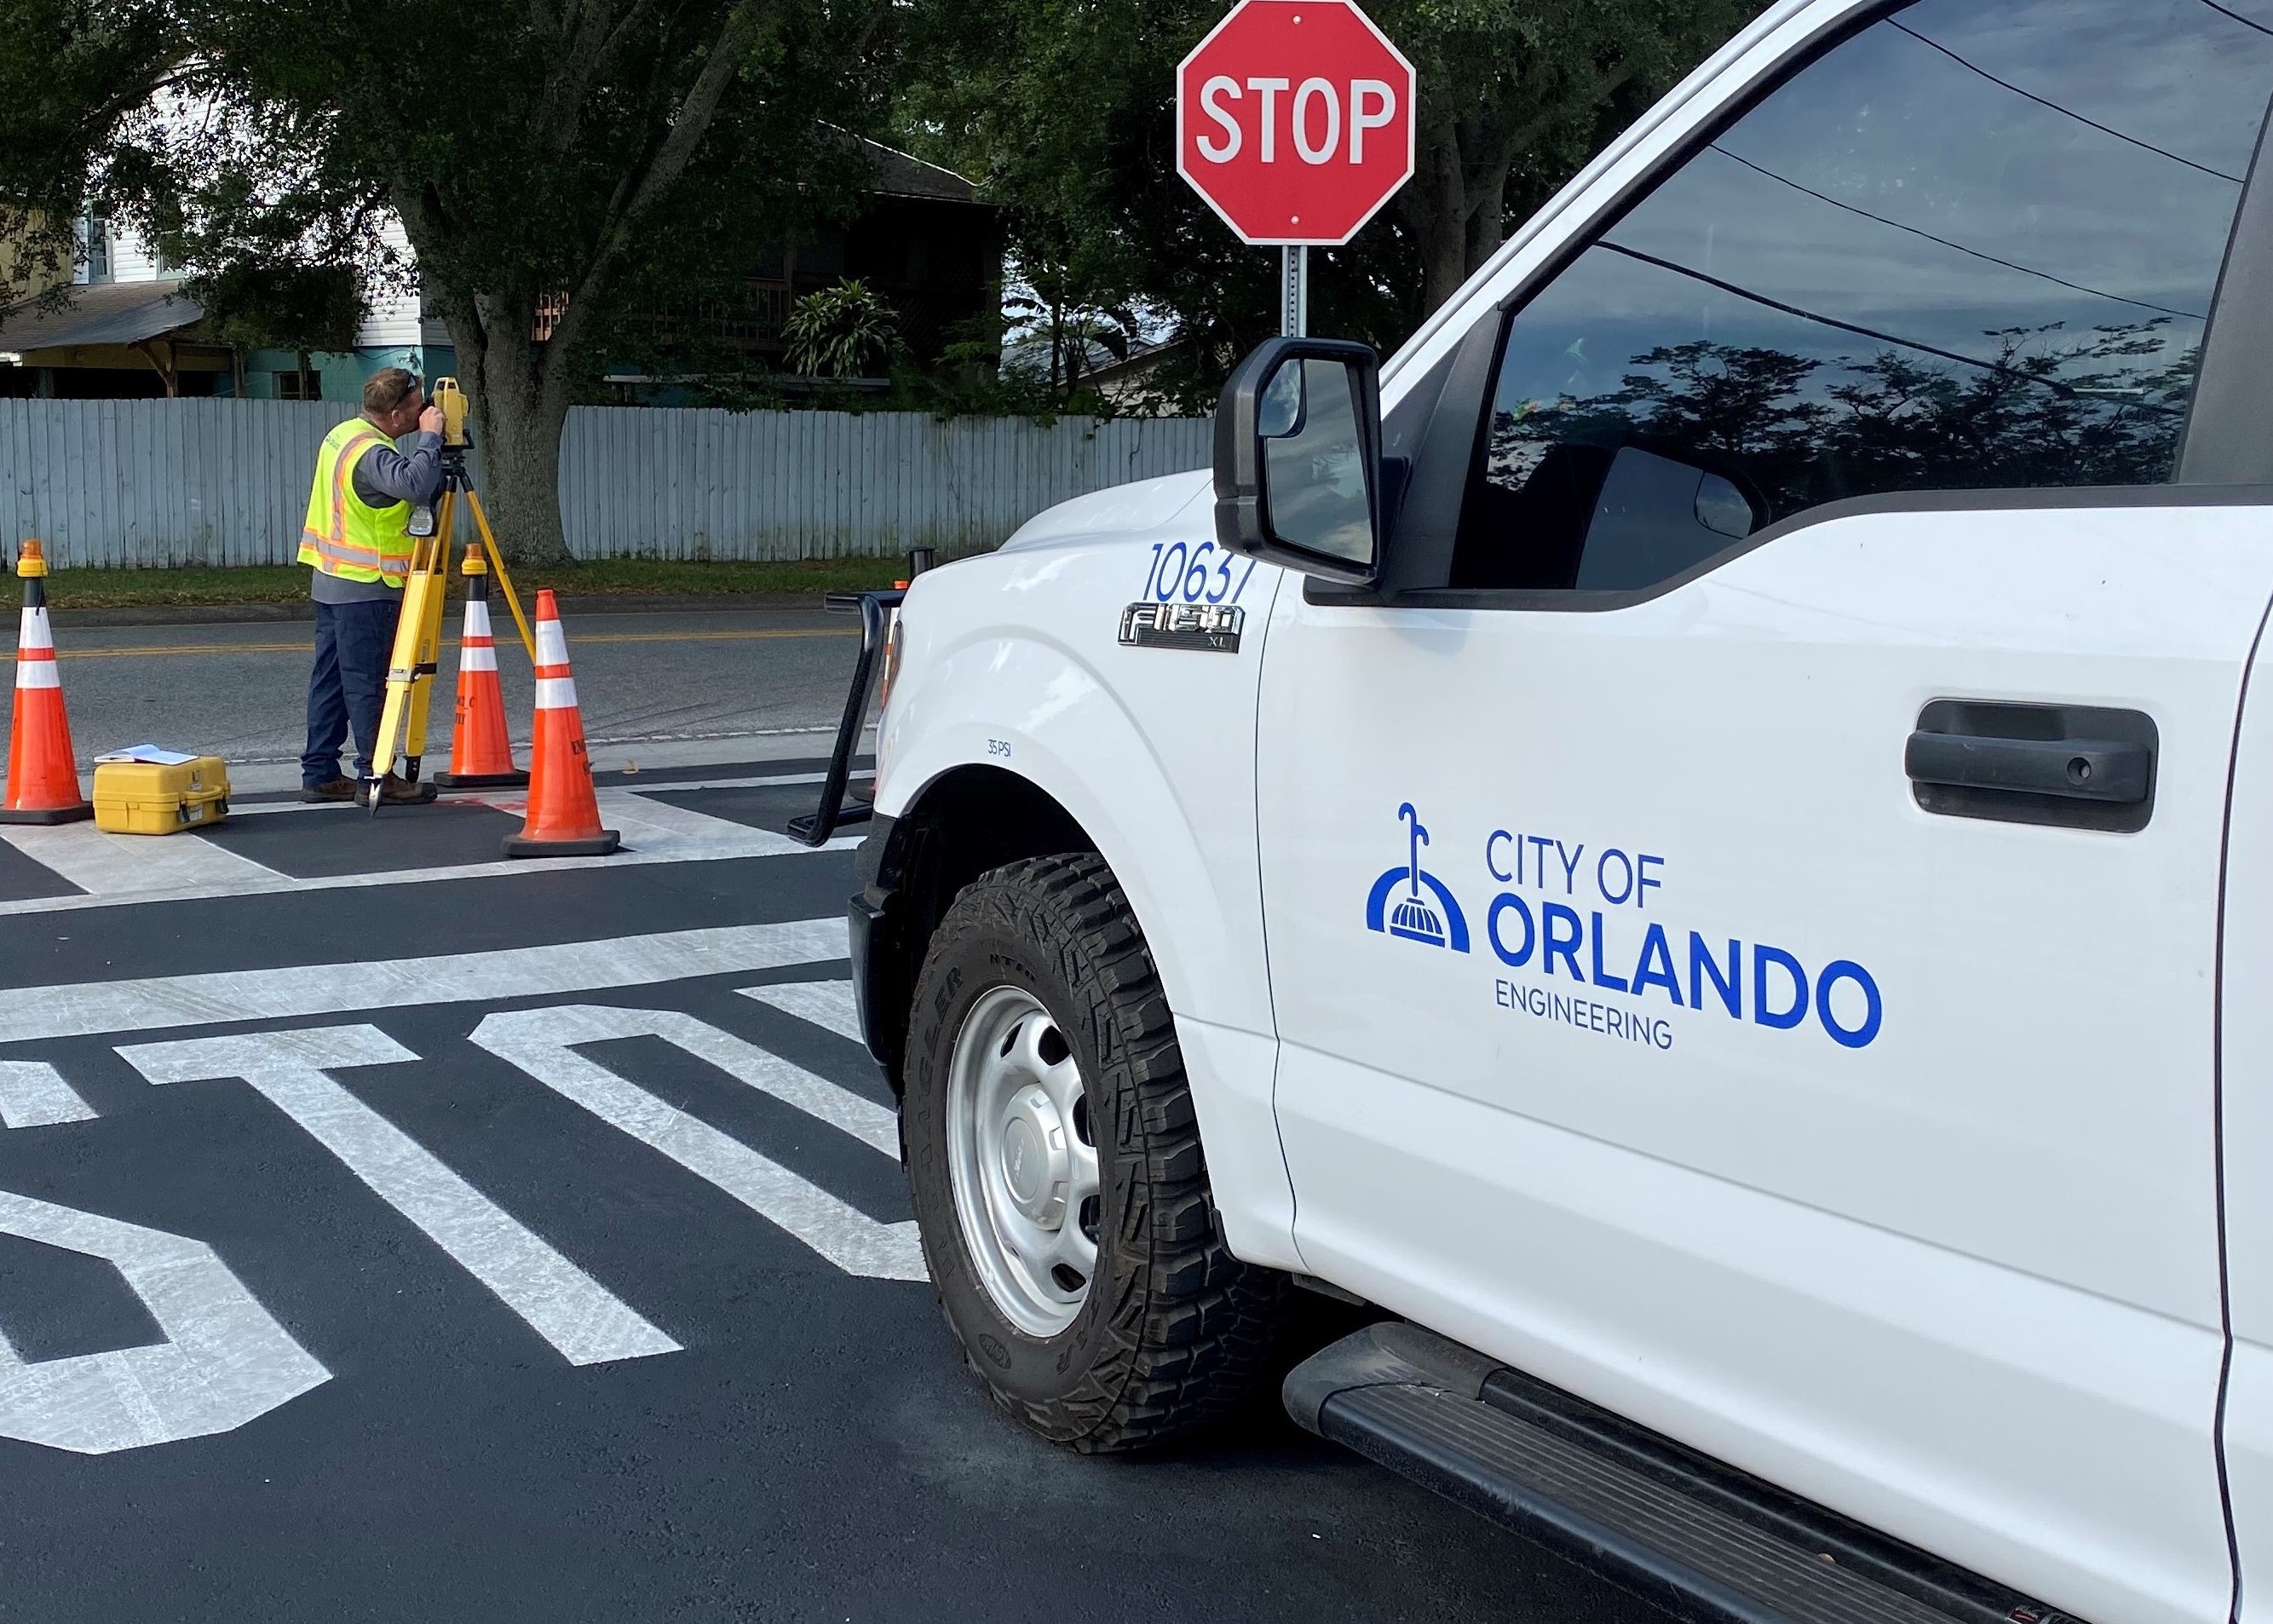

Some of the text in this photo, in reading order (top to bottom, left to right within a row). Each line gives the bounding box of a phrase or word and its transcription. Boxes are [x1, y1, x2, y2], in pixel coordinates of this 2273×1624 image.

[1196, 75, 1396, 165] STOP
[998, 740, 1012, 757] PSI
[1486, 829, 1666, 908] CITY OF
[1487, 891, 1883, 1049] ORLANDO
[1495, 978, 1673, 1051] ENGINEERING
[0, 979, 932, 1455] STO
